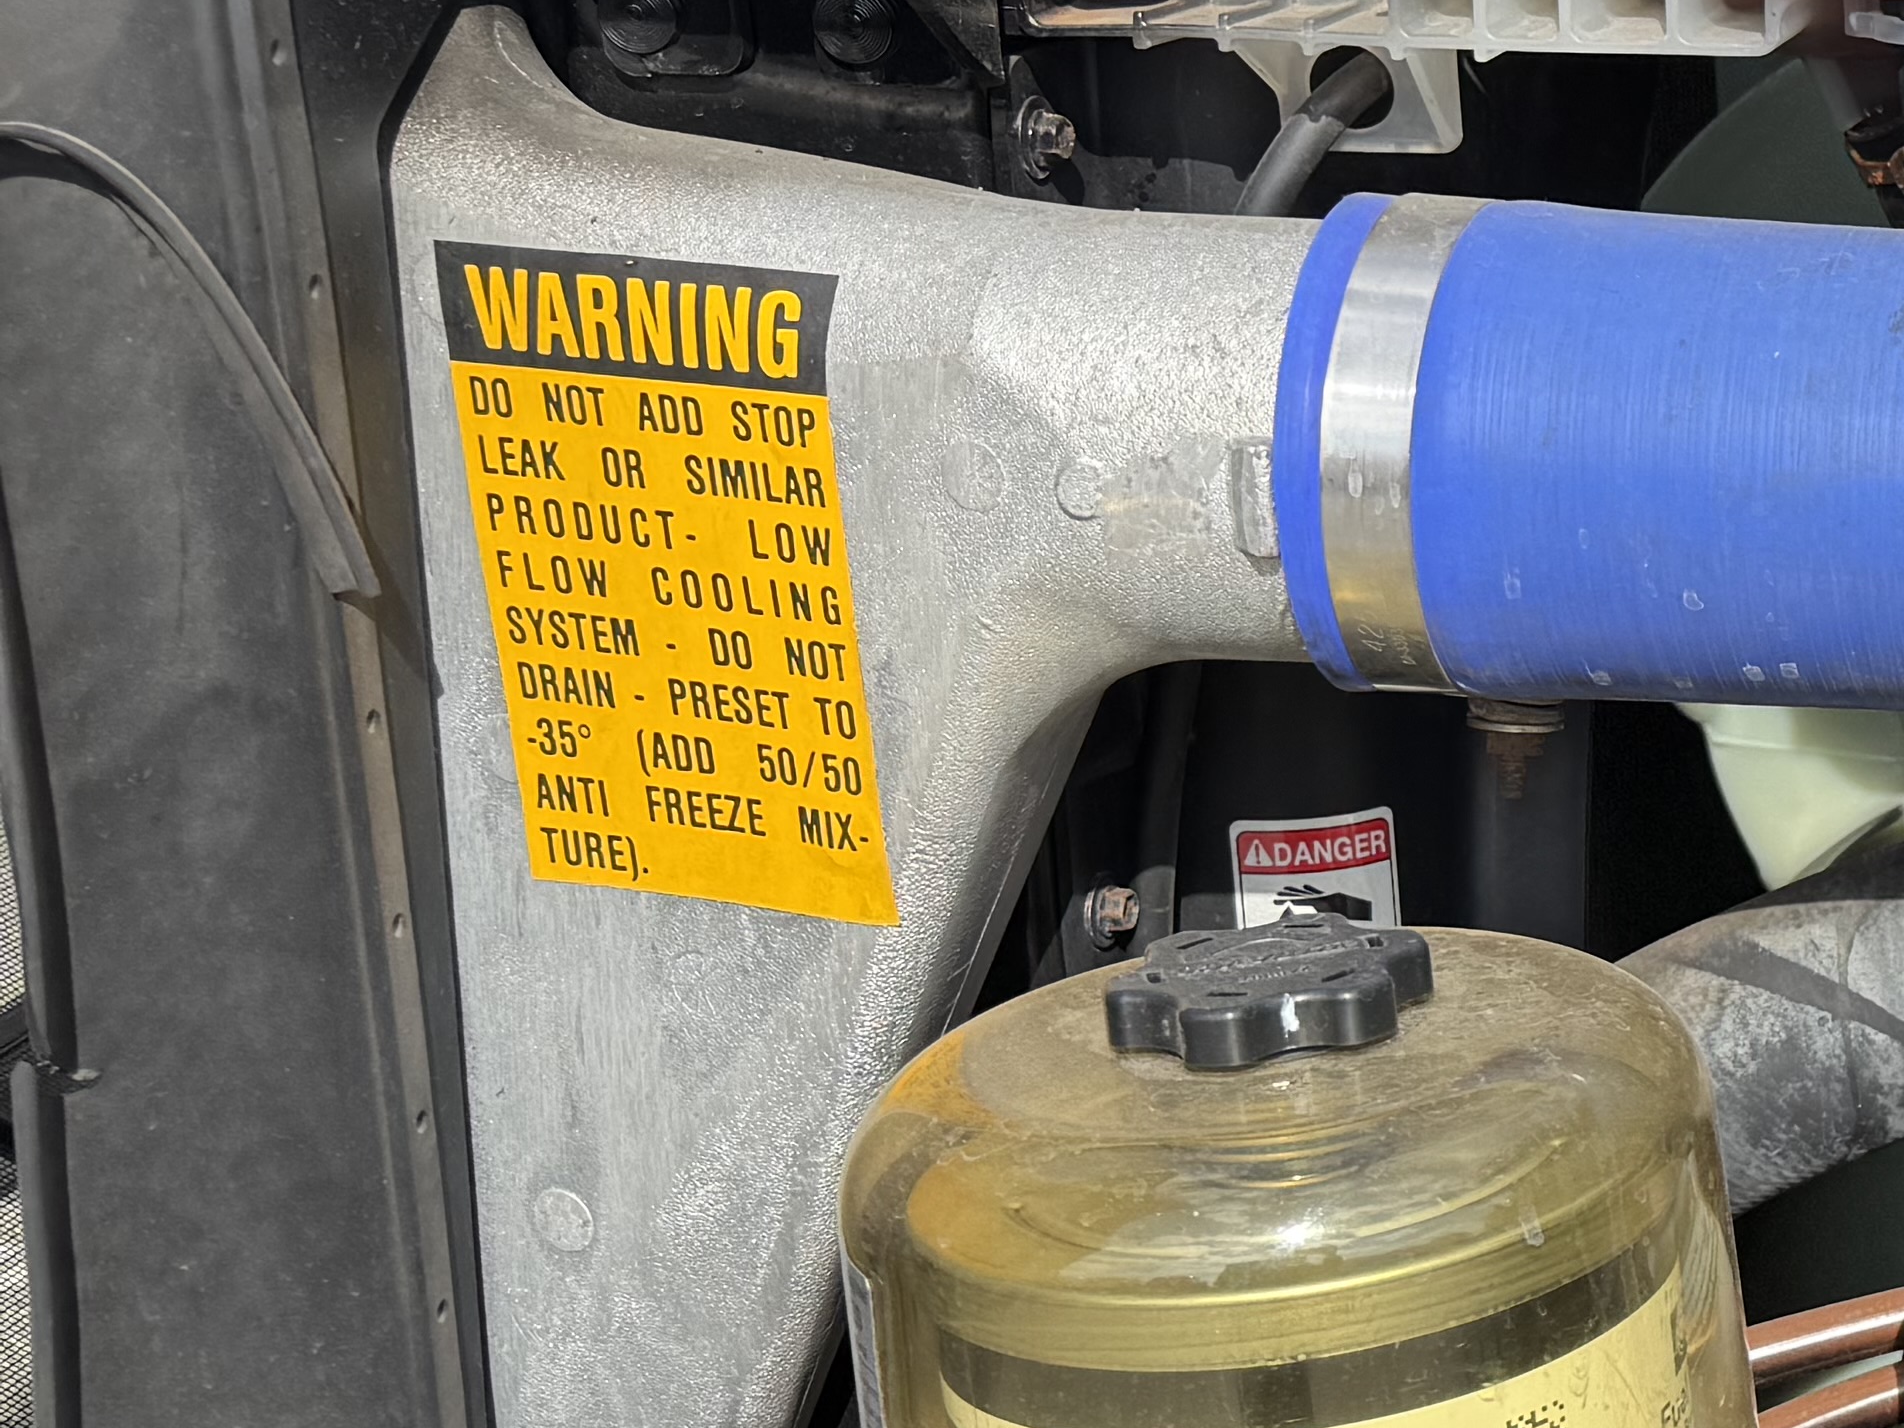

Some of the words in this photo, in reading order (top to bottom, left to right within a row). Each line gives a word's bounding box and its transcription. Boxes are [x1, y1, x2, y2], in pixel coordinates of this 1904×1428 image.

[463, 263, 802, 379] WARNING
[470, 375, 512, 420] DO
[544, 381, 606, 427] NOT
[639, 392, 703, 438] ADD
[731, 399, 817, 448] STOP
[478, 436, 565, 482] LEAK
[602, 448, 645, 490] OR
[685, 455, 827, 509] SIMILAR
[487, 493, 698, 551] PRODUCT-
[750, 519, 833, 567] LOW
[499, 550, 608, 600] FLOW
[653, 567, 842, 627] COOLING
[507, 605, 641, 659] SYSTEM
[708, 628, 752, 672] DO
[786, 636, 848, 683] NOT
[518, 661, 615, 710] DRAIN
[671, 682, 790, 732] PRESET
[812, 695, 857, 740] TO
[636, 728, 716, 777] (ADD
[757, 742, 863, 796] 50/50
[536, 772, 608, 819] ANTI
[647, 785, 767, 839] FREEZE
[798, 804, 870, 854] MIX-
[1273, 829, 1387, 867] DANGER
[541, 827, 649, 883] TURE).
